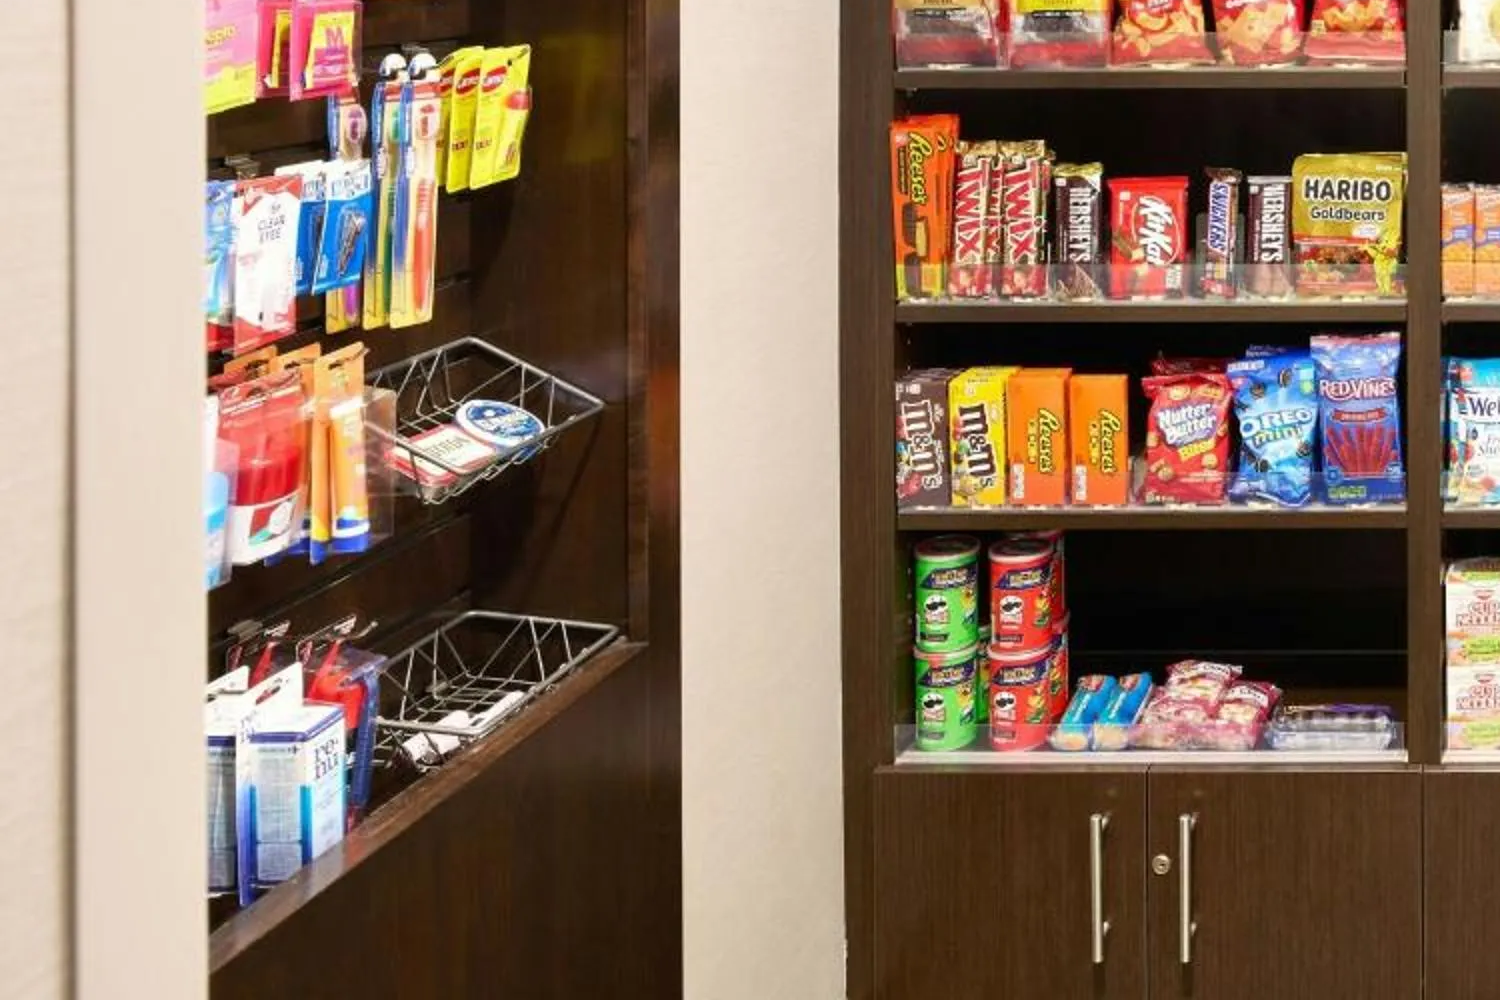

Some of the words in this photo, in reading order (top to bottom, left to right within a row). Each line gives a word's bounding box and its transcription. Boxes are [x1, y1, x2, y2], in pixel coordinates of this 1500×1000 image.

[1304, 179, 1391, 202] HARIBO
[1311, 206, 1385, 221] Goldbears
[1238, 407, 1314, 435] OREO
